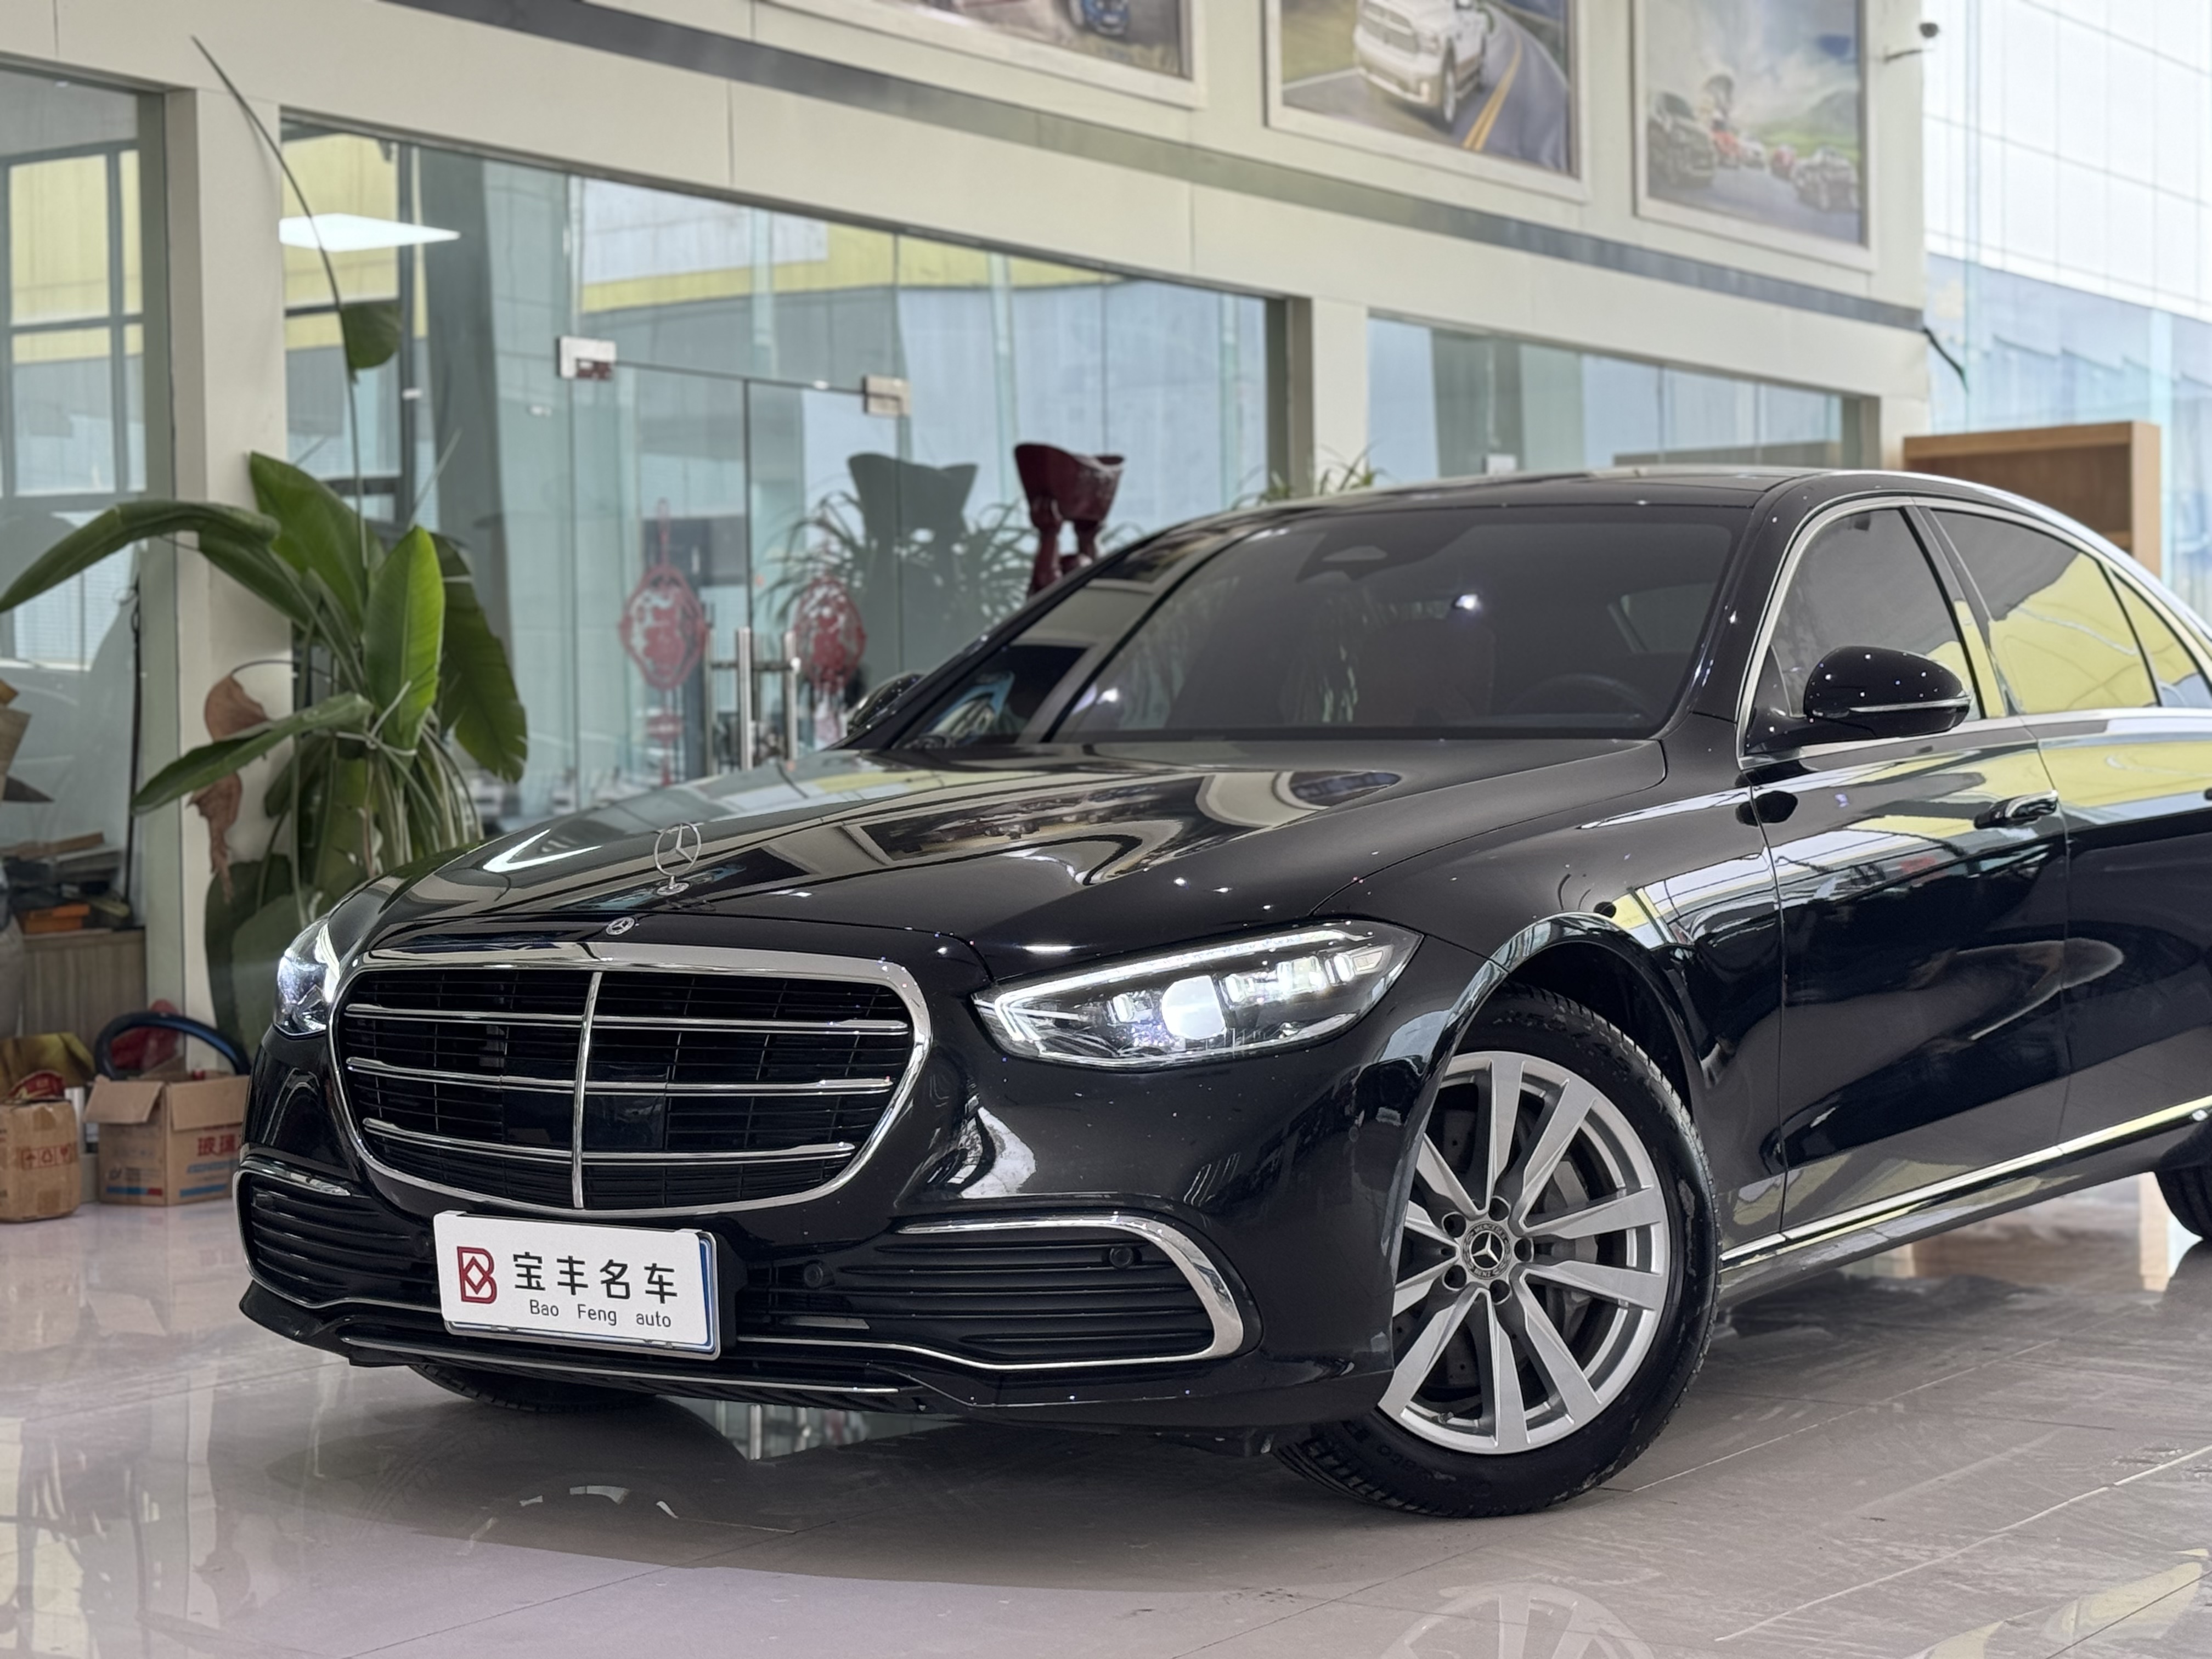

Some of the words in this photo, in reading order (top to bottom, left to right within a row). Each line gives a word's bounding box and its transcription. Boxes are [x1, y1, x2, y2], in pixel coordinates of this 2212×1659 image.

[198, 1133, 242, 1157] 玻璃
[513, 1251, 678, 1304] 宝丰名车
[529, 1299, 559, 1317] Bao
[577, 1304, 617, 1326] Feng
[636, 1311, 671, 1328] auto
